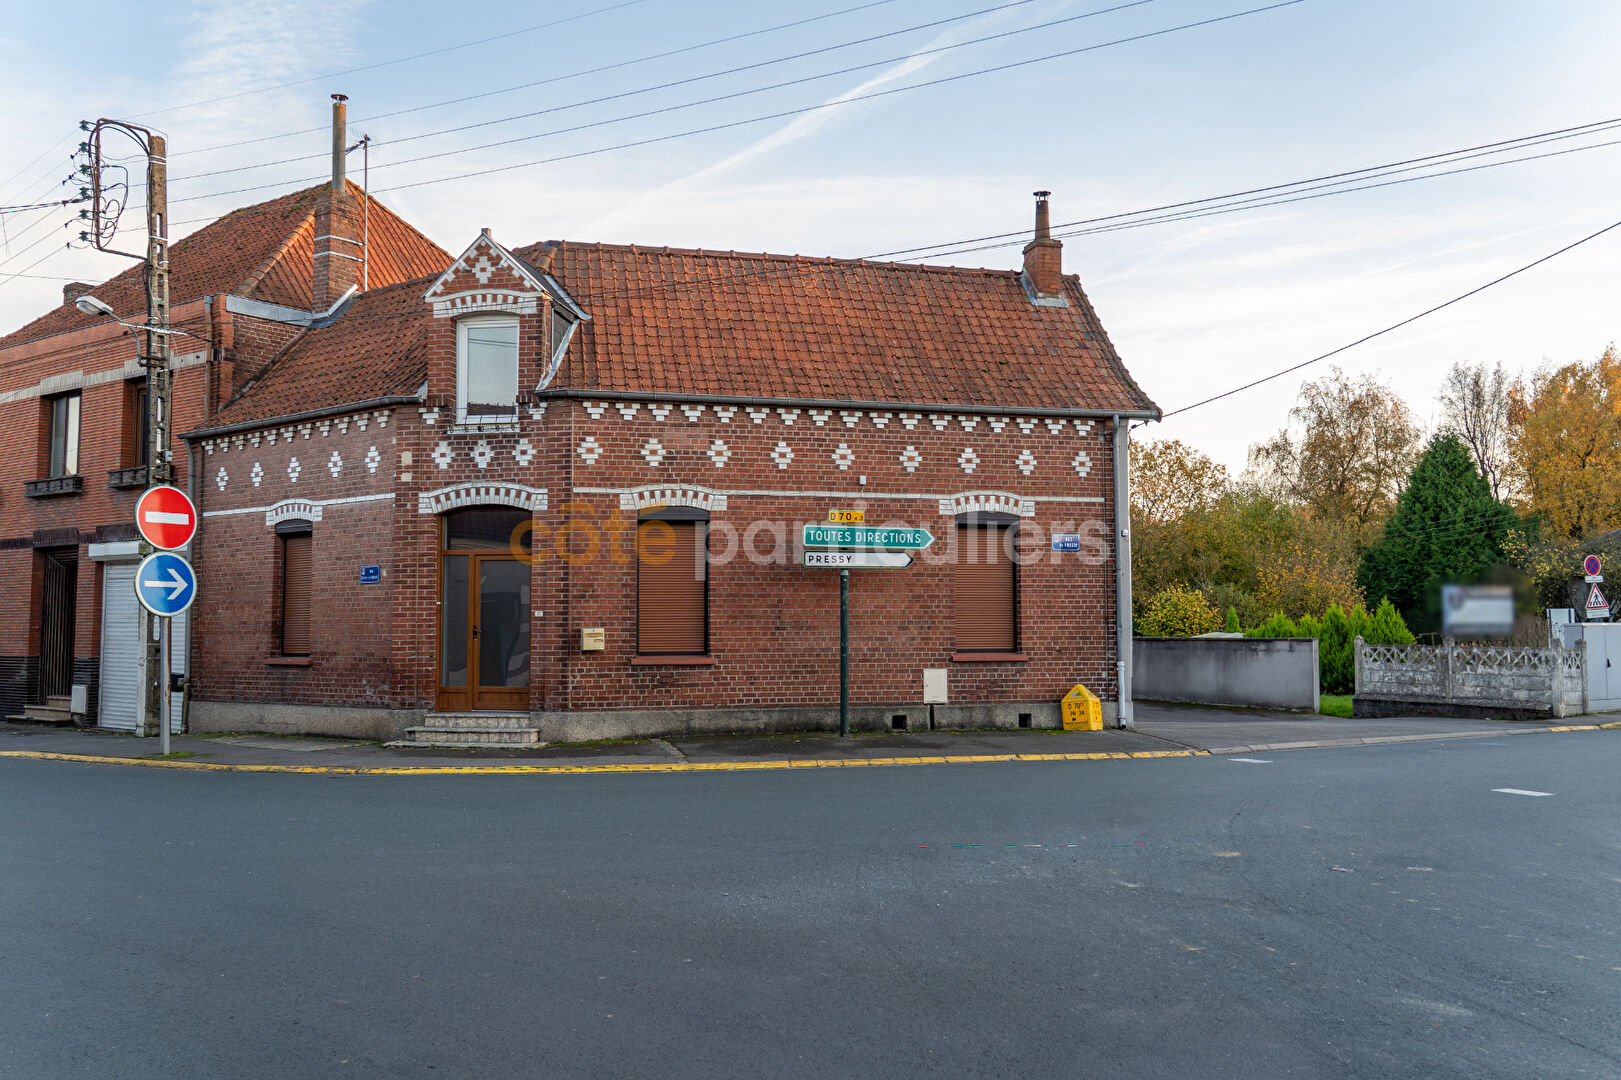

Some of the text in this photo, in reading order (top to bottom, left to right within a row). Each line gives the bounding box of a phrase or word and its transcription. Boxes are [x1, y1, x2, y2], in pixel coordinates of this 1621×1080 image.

[839, 513, 852, 521] 70
[809, 530, 921, 544] TOUTES DIRECTIONS
[808, 555, 852, 563] PRESSY
